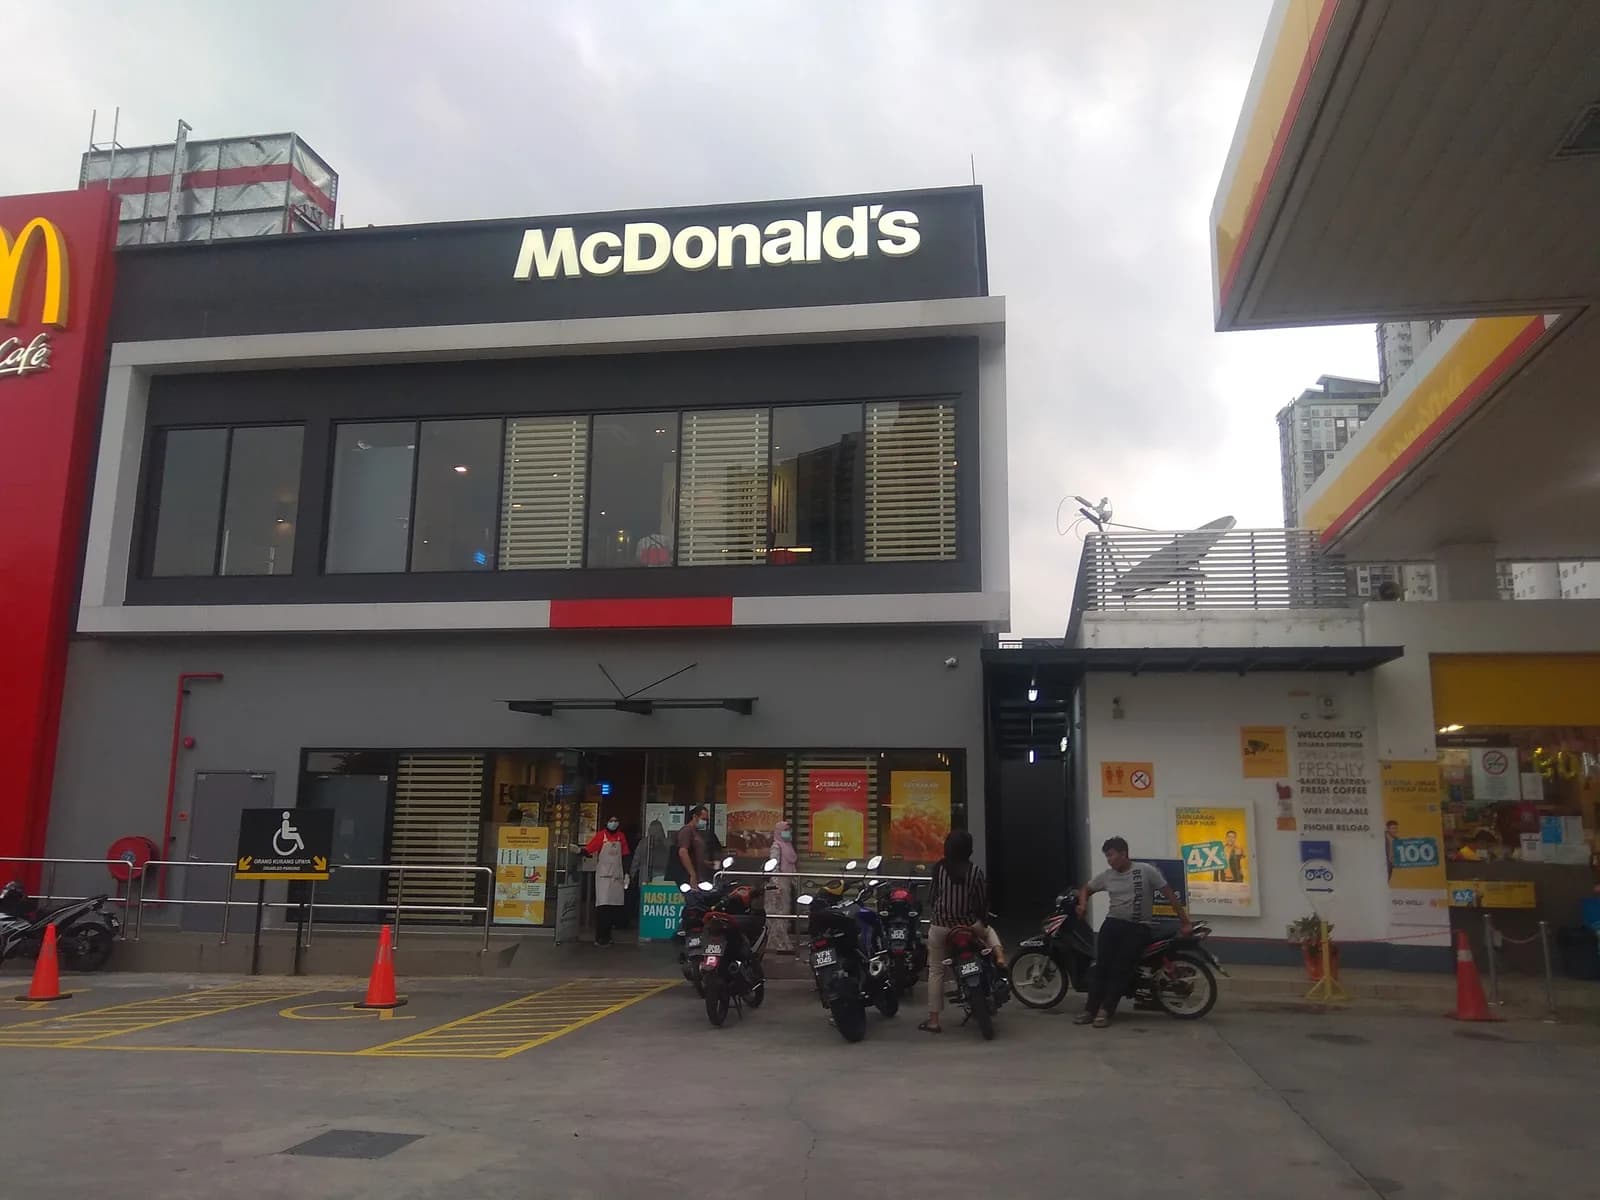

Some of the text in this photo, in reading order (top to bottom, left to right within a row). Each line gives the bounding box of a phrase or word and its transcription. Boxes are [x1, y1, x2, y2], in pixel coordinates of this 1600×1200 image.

[513, 204, 921, 279] McDonald's
[1297, 731, 1345, 739] WELCOME
[1298, 762, 1364, 777] FRESHLY
[1300, 786, 1330, 794] FRESH
[1325, 808, 1368, 816] AVAILABLE
[1336, 824, 1370, 832] RELOAD
[1187, 846, 1224, 868] 4X
[1396, 843, 1434, 862] 100
[644, 892, 666, 904] NASI
[643, 905, 676, 917] PANAS
[665, 918, 676, 929] DI
